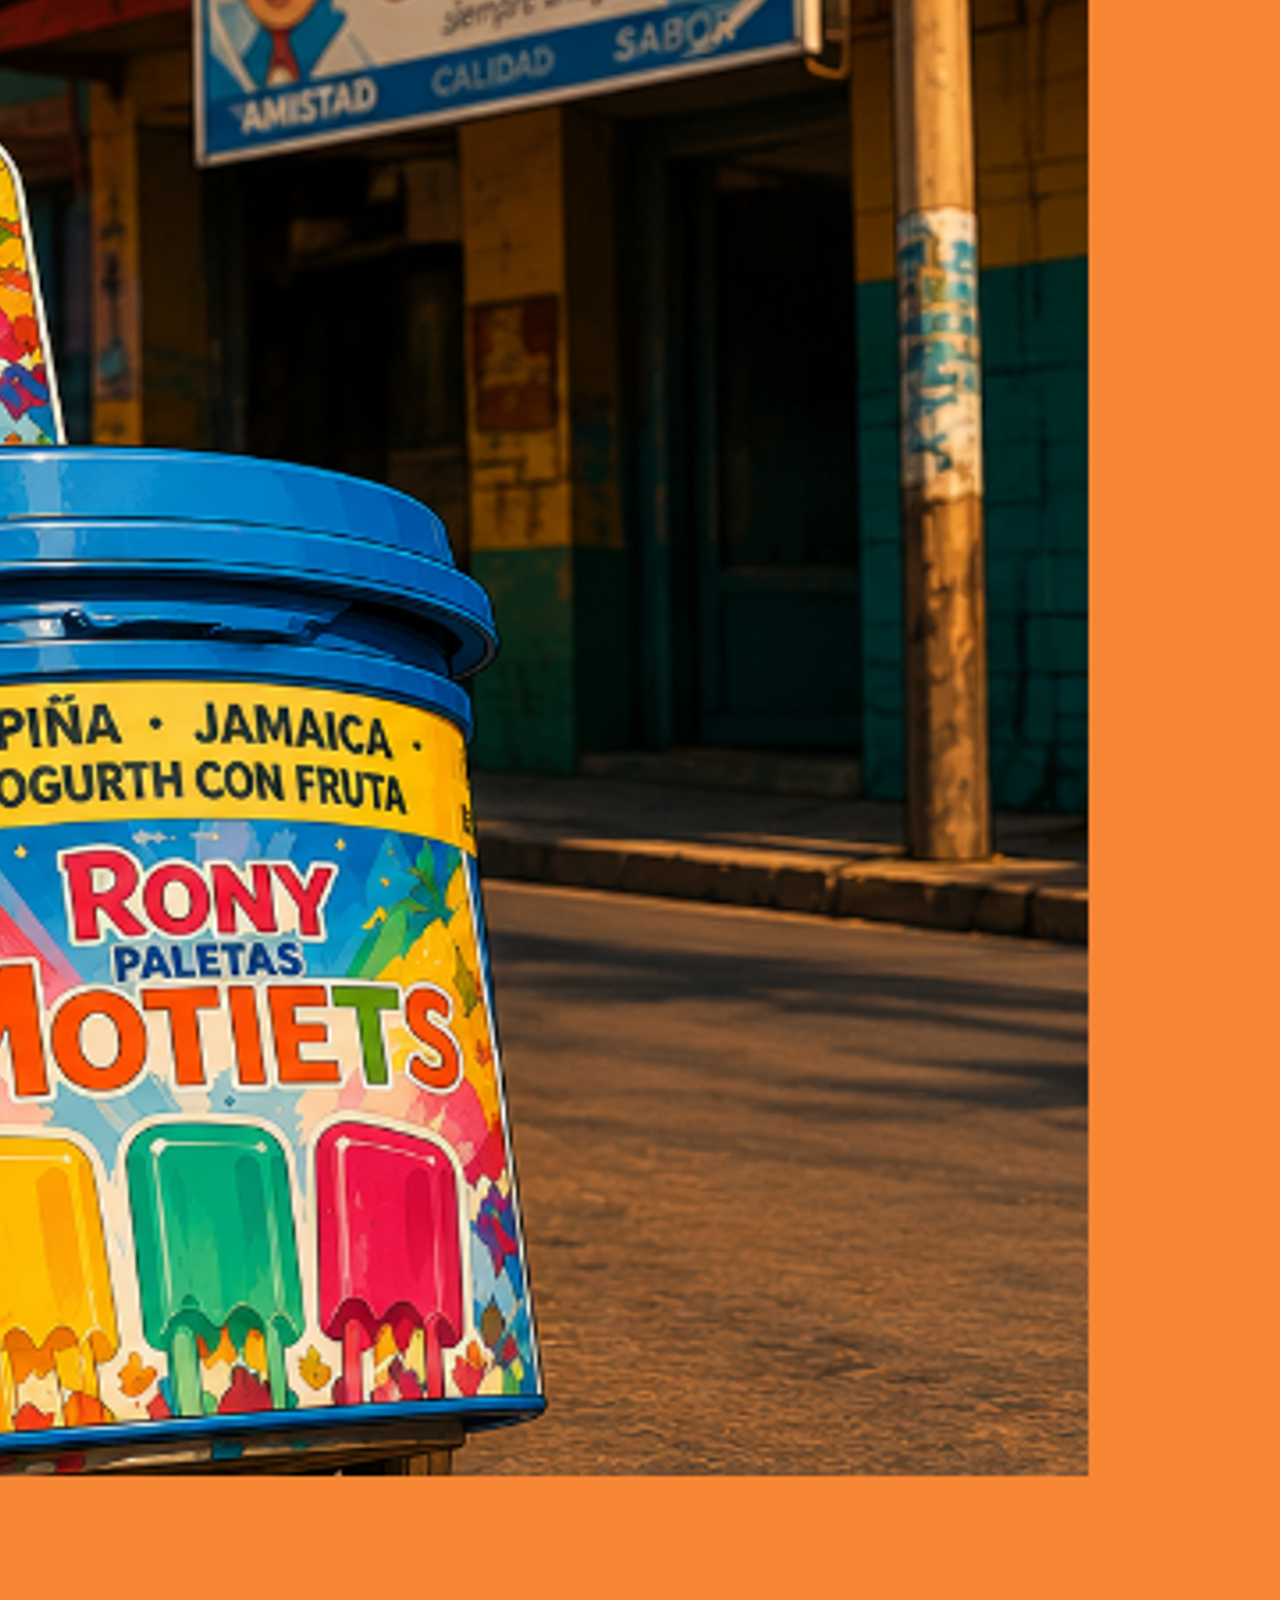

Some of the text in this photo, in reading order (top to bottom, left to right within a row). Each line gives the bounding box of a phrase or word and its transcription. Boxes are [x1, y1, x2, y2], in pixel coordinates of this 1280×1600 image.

[430, 46, 556, 96] CALIDAD
[195, 702, 393, 760] JAMAICA
[195, 762, 287, 800] CON
[297, 764, 408, 815] FRUTA
[58, 847, 336, 944] RONY
[111, 940, 304, 984] PALETAS
